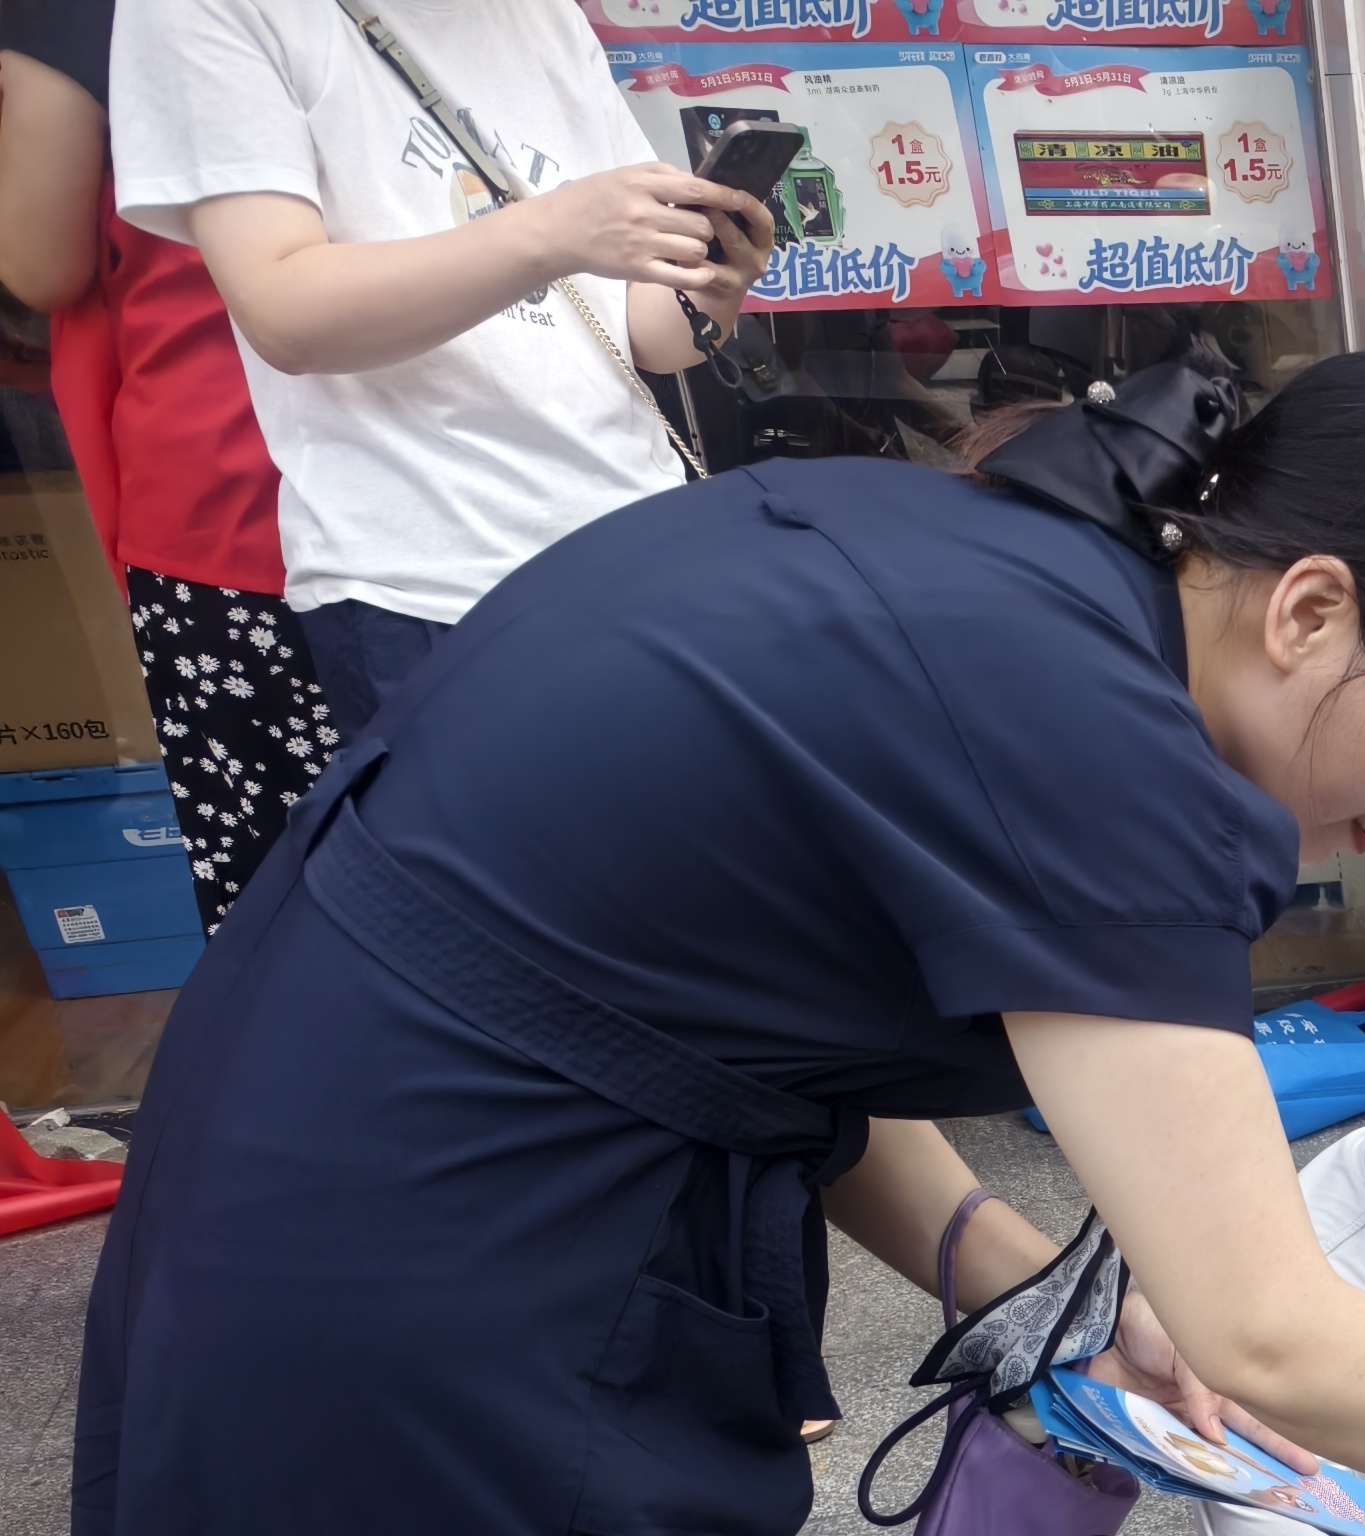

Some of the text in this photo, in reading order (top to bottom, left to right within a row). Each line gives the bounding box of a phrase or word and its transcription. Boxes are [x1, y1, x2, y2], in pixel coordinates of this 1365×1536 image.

[877, 161, 942, 185] 1.5元
[1223, 158, 1284, 182] 1.5元
[1070, 188, 1161, 198] WILD TIGER
[1079, 235, 1255, 292] 超值低价
[530, 307, 556, 328] eat
